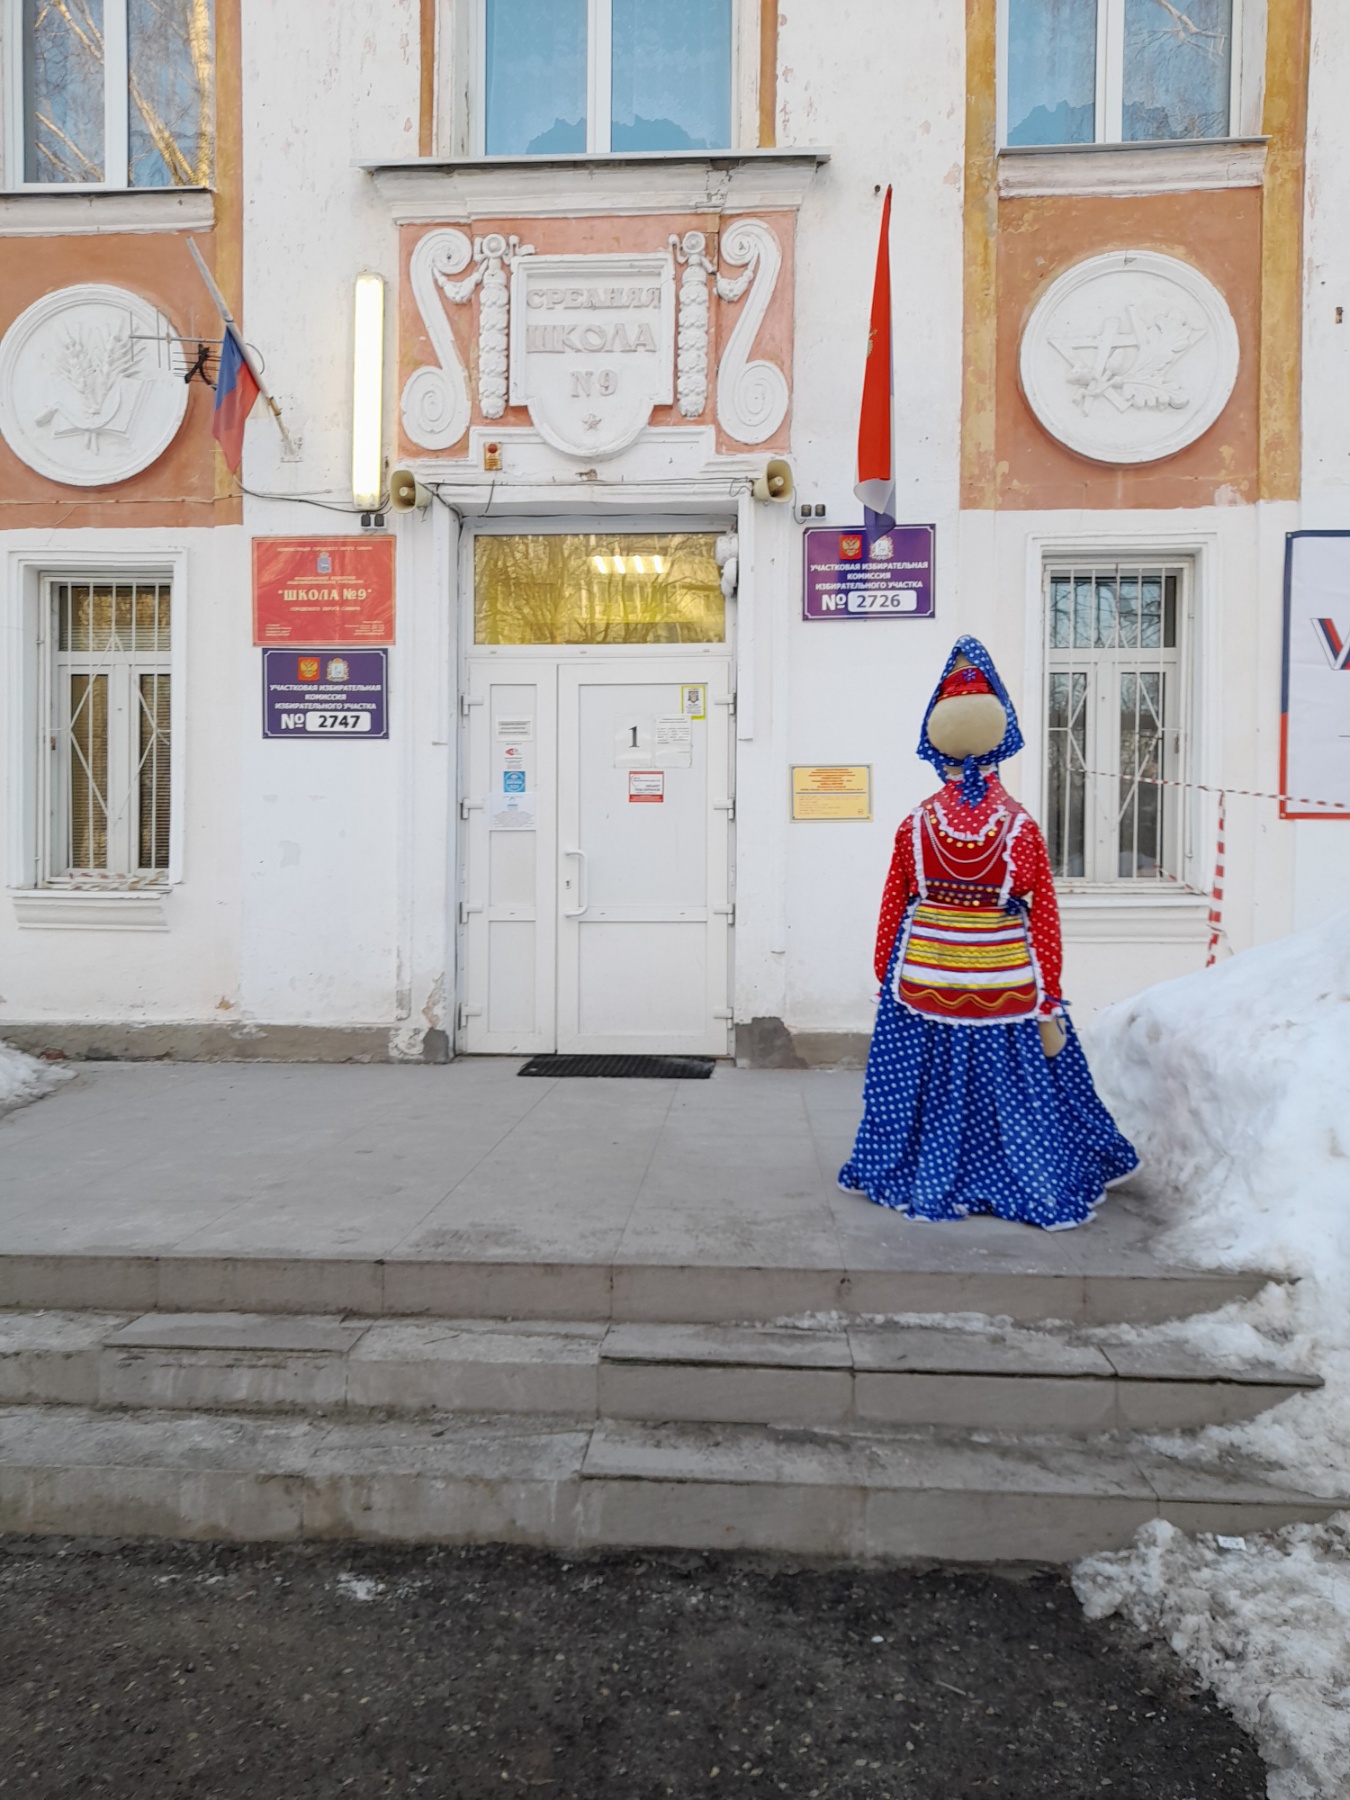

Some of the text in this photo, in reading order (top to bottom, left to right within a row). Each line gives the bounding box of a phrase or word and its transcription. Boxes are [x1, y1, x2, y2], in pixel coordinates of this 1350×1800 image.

[526, 287, 661, 310] СРЕДНЯЯ
[526, 323, 657, 353] ШКОЛА
[810, 561, 928, 571] УЧАСТКОВАЯ ИЗБИРАТЕЛЬНАЯ
[847, 572, 891, 580] КОМИССИЯ
[815, 581, 923, 590] ИЗБИРАТЕЛЬНОГО УЧАСТКА
[856, 594, 901, 608] 2726
[274, 702, 342, 710] ИЗБИРАТЕЛЬНОГО
[318, 715, 361, 729] 2747
[628, 725, 641, 749] 1
